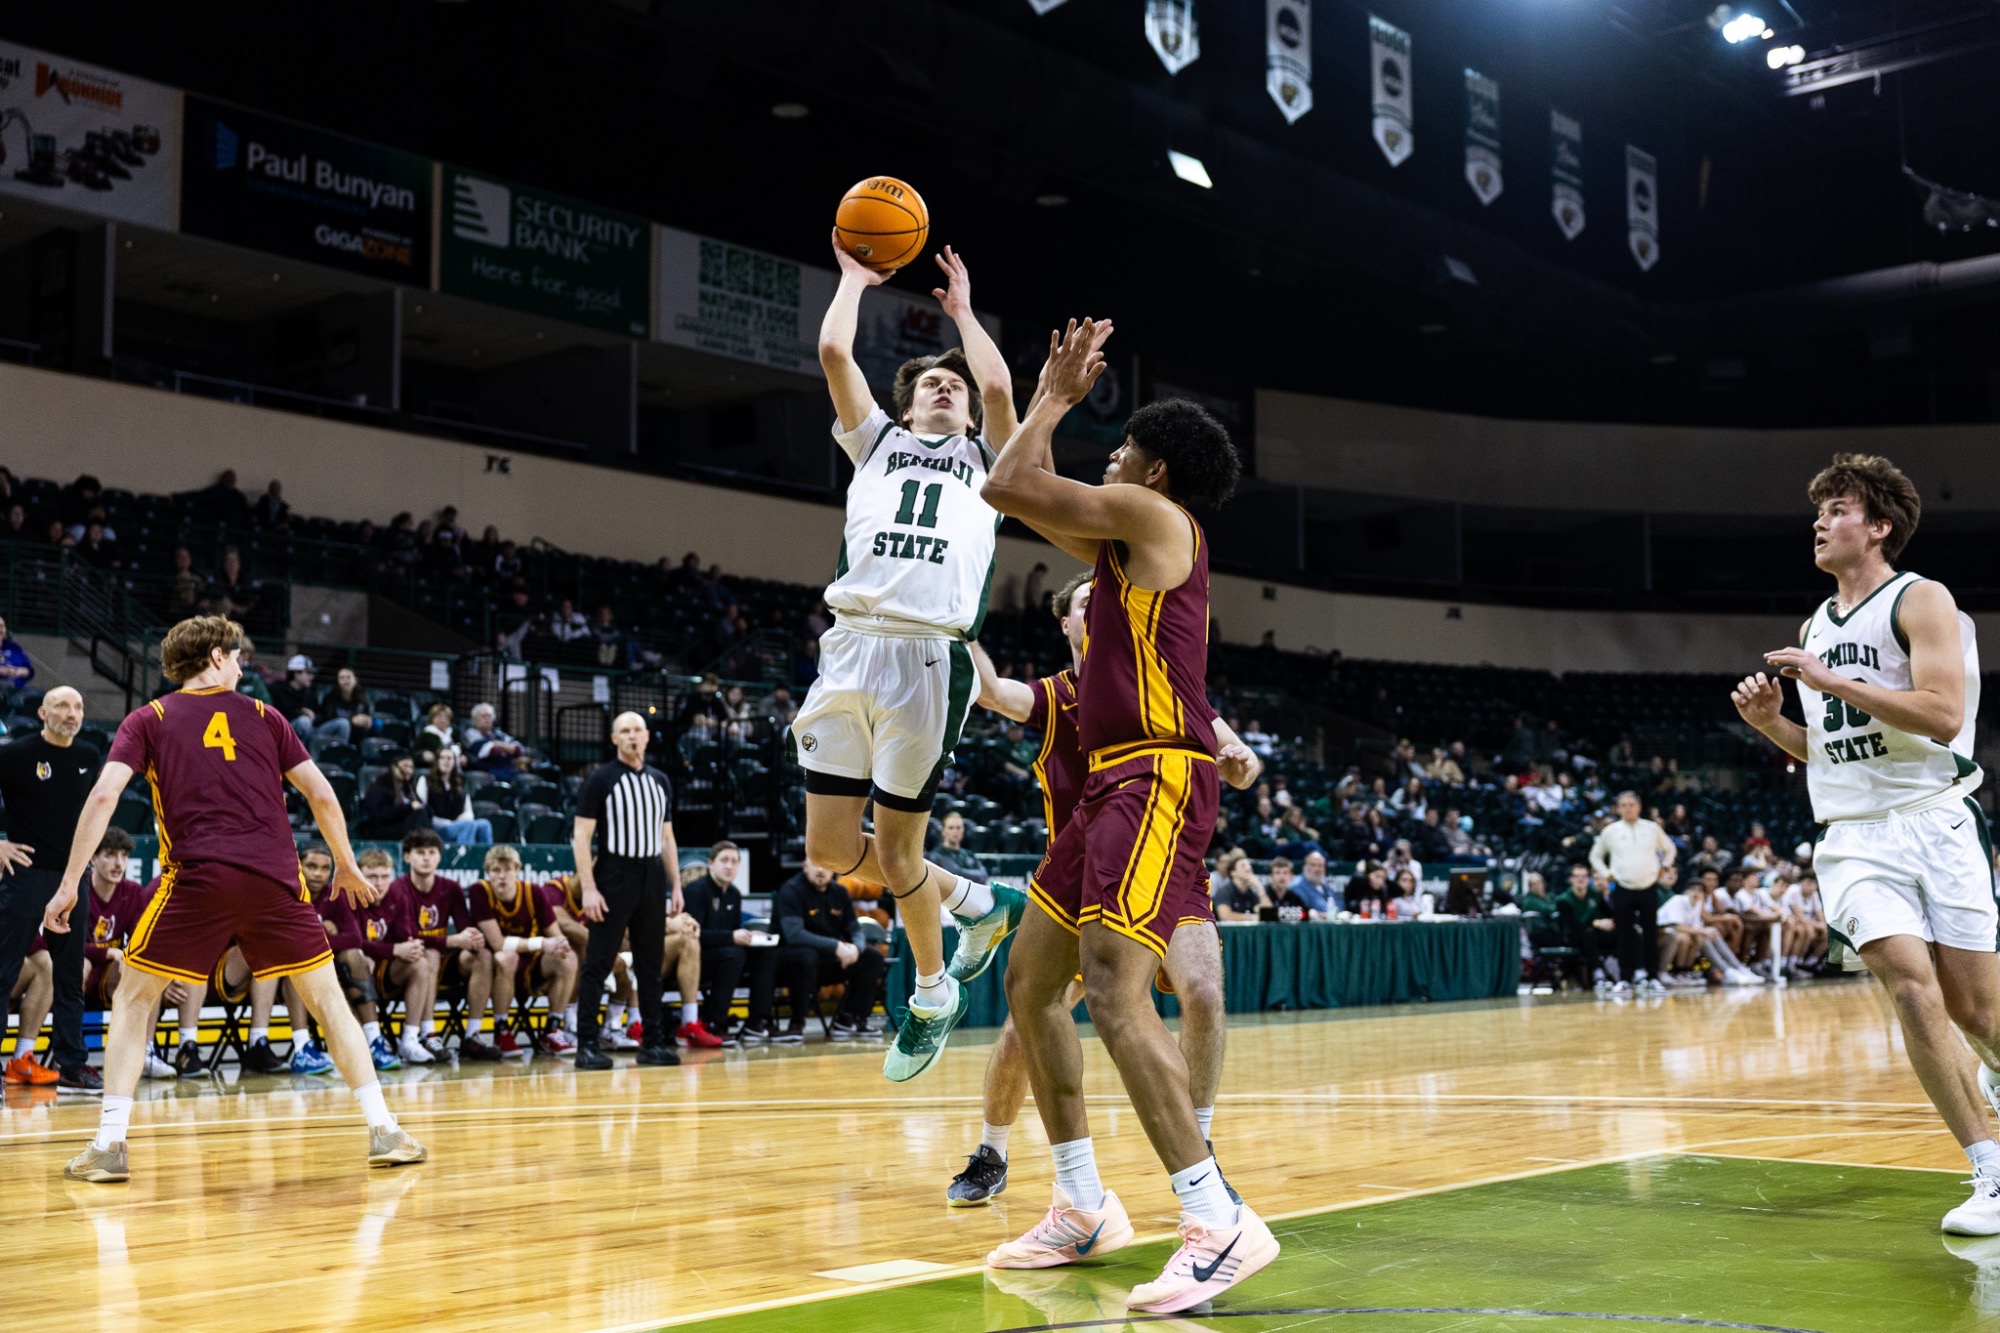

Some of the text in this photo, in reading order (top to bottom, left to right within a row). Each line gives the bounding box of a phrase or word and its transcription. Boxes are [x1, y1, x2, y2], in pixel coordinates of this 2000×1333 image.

[246, 140, 308, 184] Paul
[314, 158, 415, 212] Bunyan
[515, 195, 640, 250] SECURITY
[515, 222, 590, 265] BANK
[471, 254, 523, 286] Here
[530, 264, 568, 294] for
[884, 452, 974, 488] BEMIDJI
[894, 479, 943, 528] 11
[873, 531, 949, 565] STATE
[203, 711, 237, 761] 4
[1824, 731, 1889, 765] STATE
